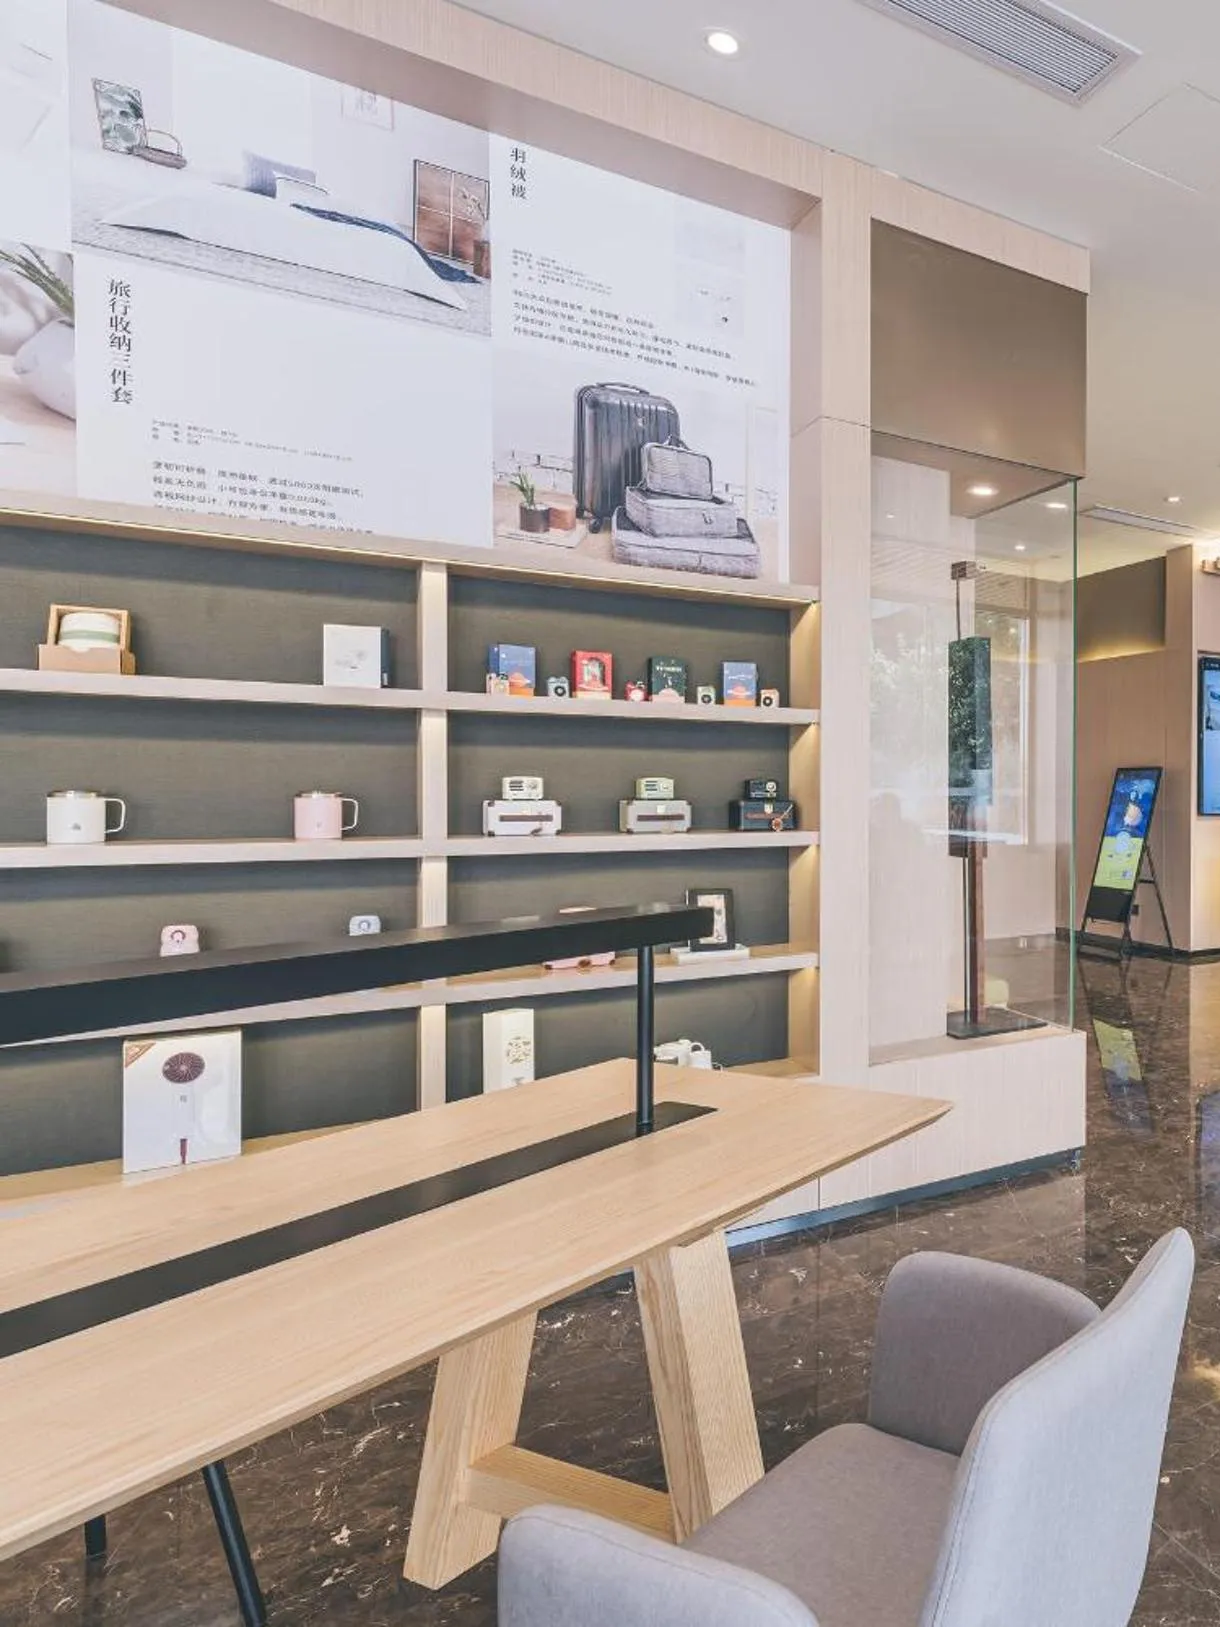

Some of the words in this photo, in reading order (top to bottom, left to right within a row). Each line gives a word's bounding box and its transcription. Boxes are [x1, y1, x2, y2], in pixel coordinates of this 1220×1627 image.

[510, 147, 527, 199] 羽绒被
[109, 279, 133, 404] 旅行收纳三件套
